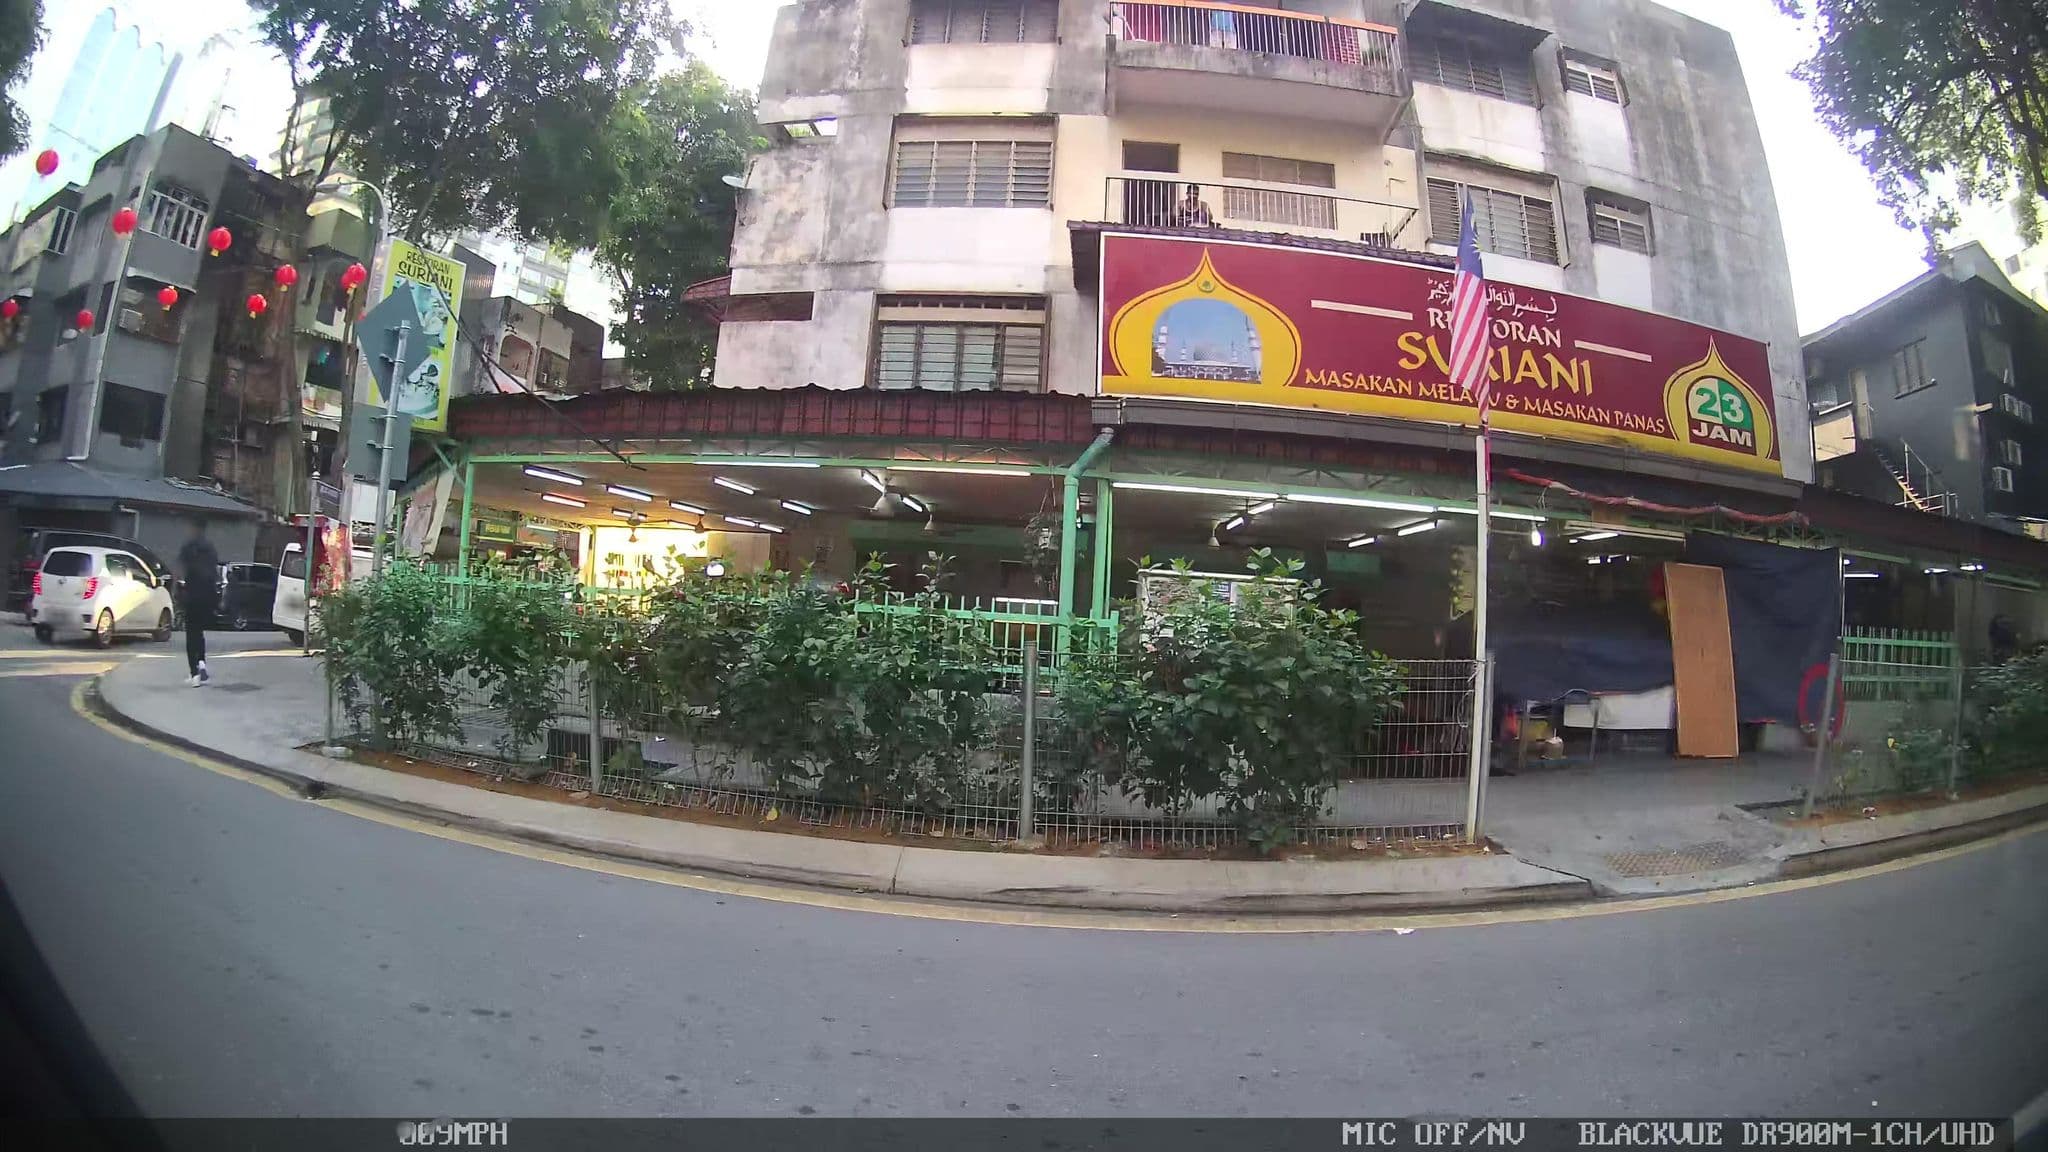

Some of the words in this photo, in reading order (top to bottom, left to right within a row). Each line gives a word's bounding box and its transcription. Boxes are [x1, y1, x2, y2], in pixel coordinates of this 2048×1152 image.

[398, 261, 453, 290] SURIANI
[1426, 307, 1561, 348] REORAN
[1305, 368, 1412, 396] MASAKAN
[1419, 382, 1500, 407] MELAU
[1506, 394, 1519, 409] &
[1524, 396, 1610, 425] MASAKAN
[1614, 410, 1665, 434] PANAS
[1696, 387, 1744, 423] 23
[1691, 422, 1752, 447] JAM
